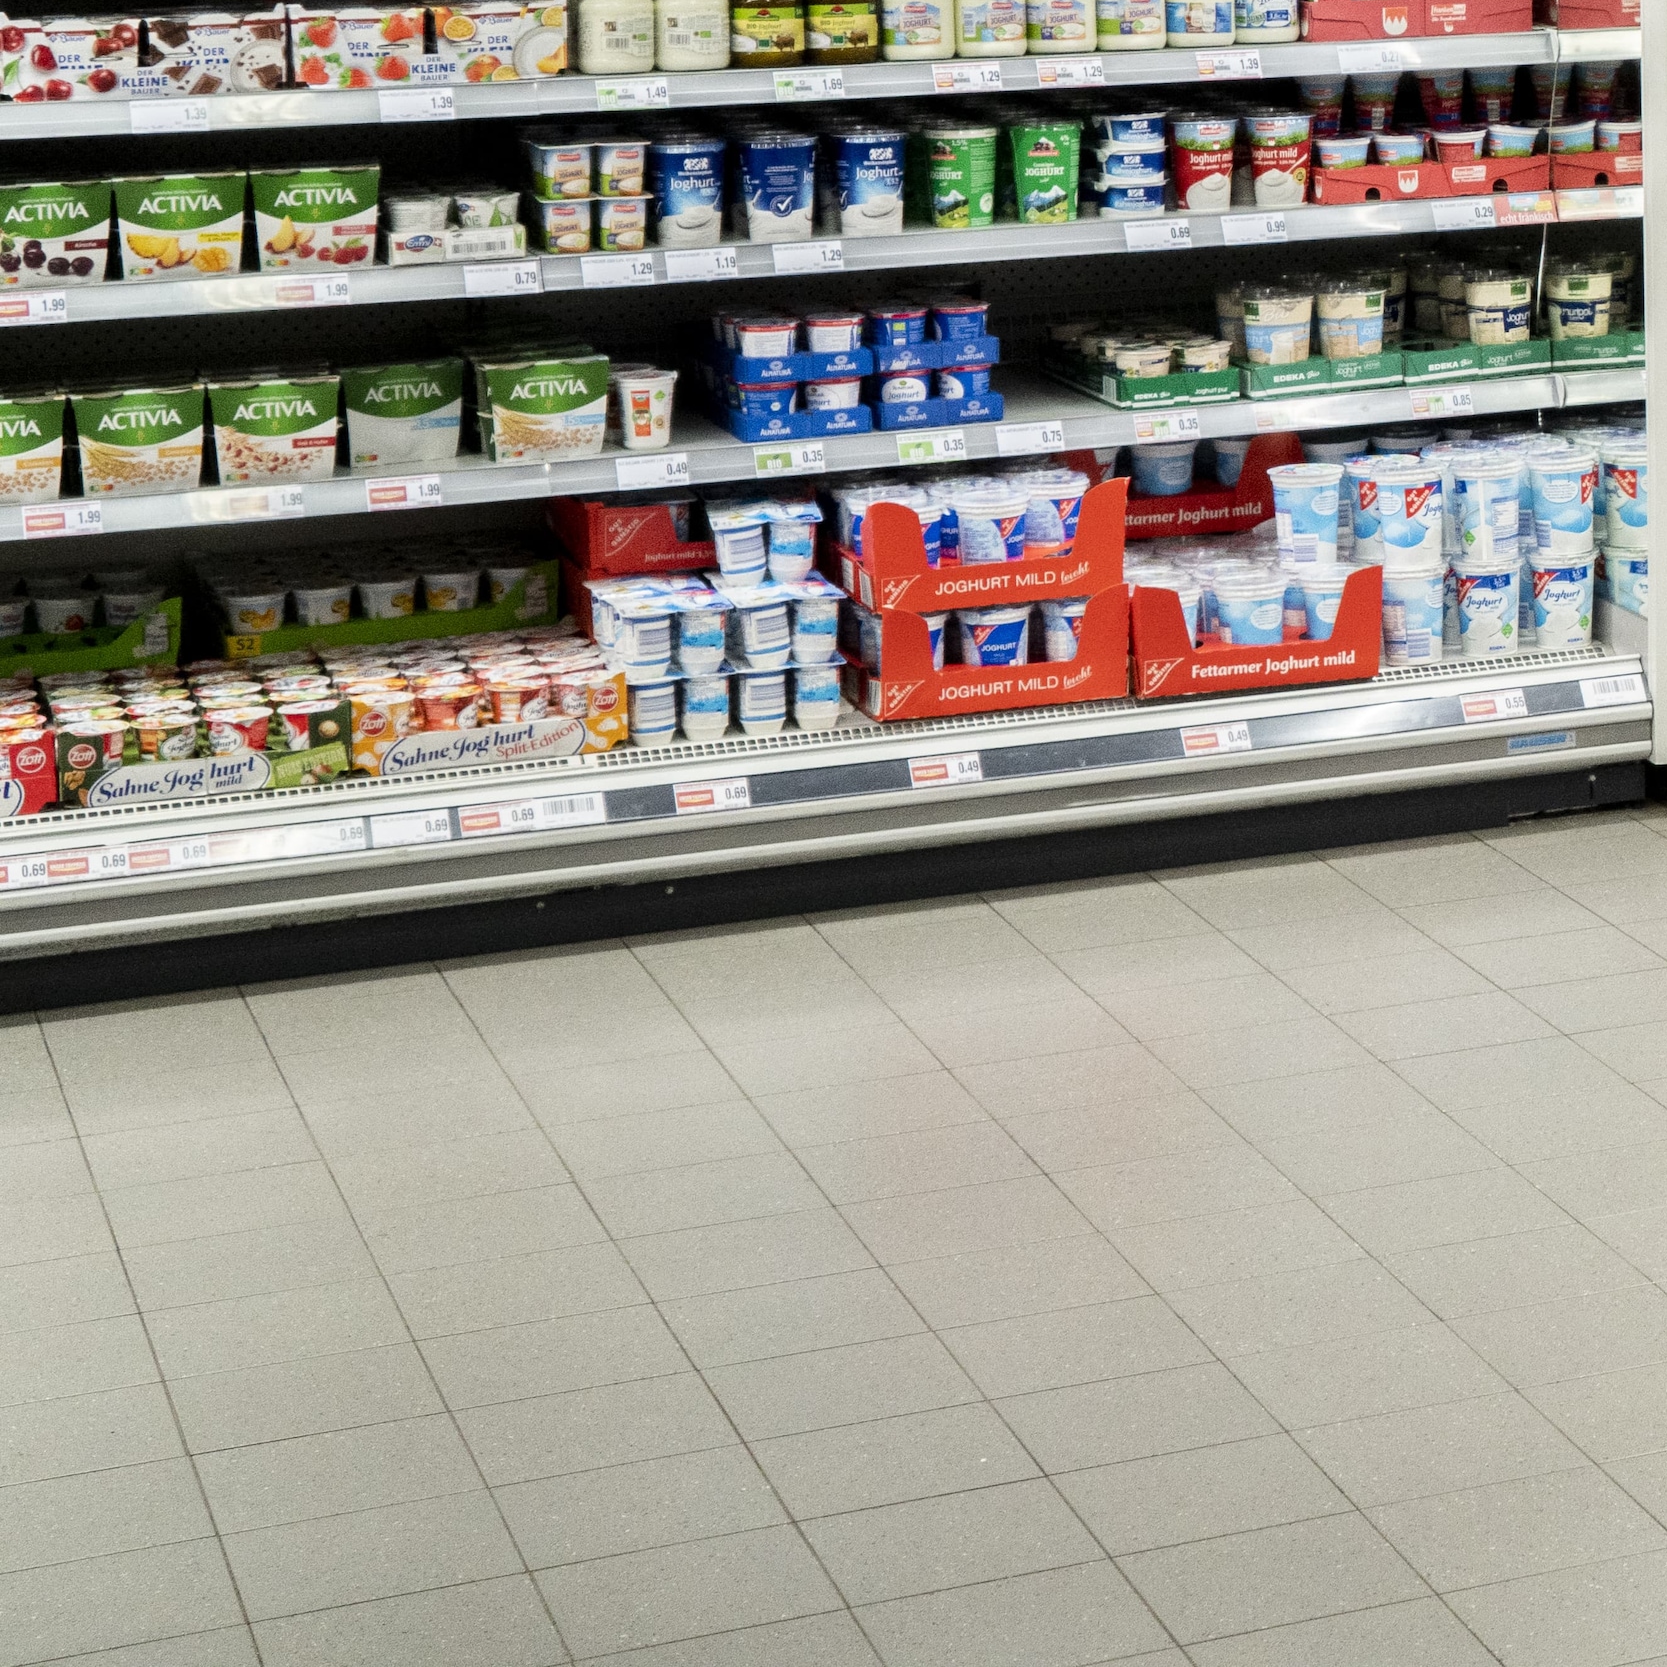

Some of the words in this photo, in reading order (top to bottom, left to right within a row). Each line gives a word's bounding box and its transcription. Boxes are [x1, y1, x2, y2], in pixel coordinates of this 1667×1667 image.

[121, 77, 169, 89] KLEINE
[137, 192, 224, 214] ACTIVIA
[273, 186, 358, 207] ACTIVIA
[4, 202, 90, 222] ACTIVIA
[97, 407, 183, 431] ACTIVIA
[935, 575, 1014, 596] JOGHURT
[1016, 571, 1057, 588] MILD
[1192, 659, 1262, 679] Fettarmer
[1265, 655, 1320, 676] Joghurt
[1323, 651, 1356, 668] mild
[99, 780, 155, 803] Sahne
[512, 808, 535, 822] 0.69
[424, 819, 449, 833] 0.69
